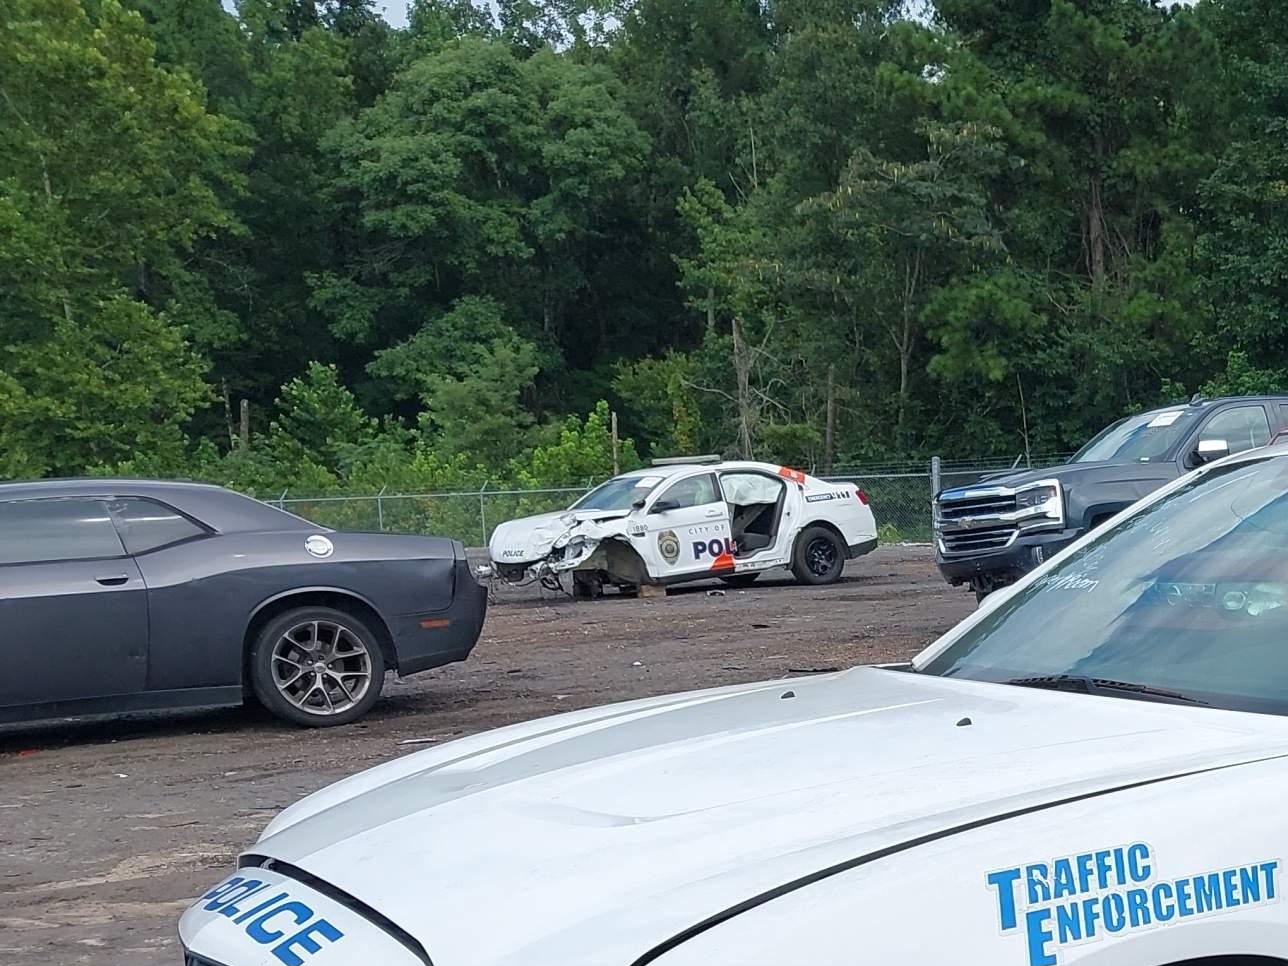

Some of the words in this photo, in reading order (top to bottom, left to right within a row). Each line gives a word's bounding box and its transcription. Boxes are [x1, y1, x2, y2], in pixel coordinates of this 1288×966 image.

[688, 526, 709, 535] CITY
[502, 549, 524, 557] POLICE
[987, 843, 1152, 931] TRAFFIC
